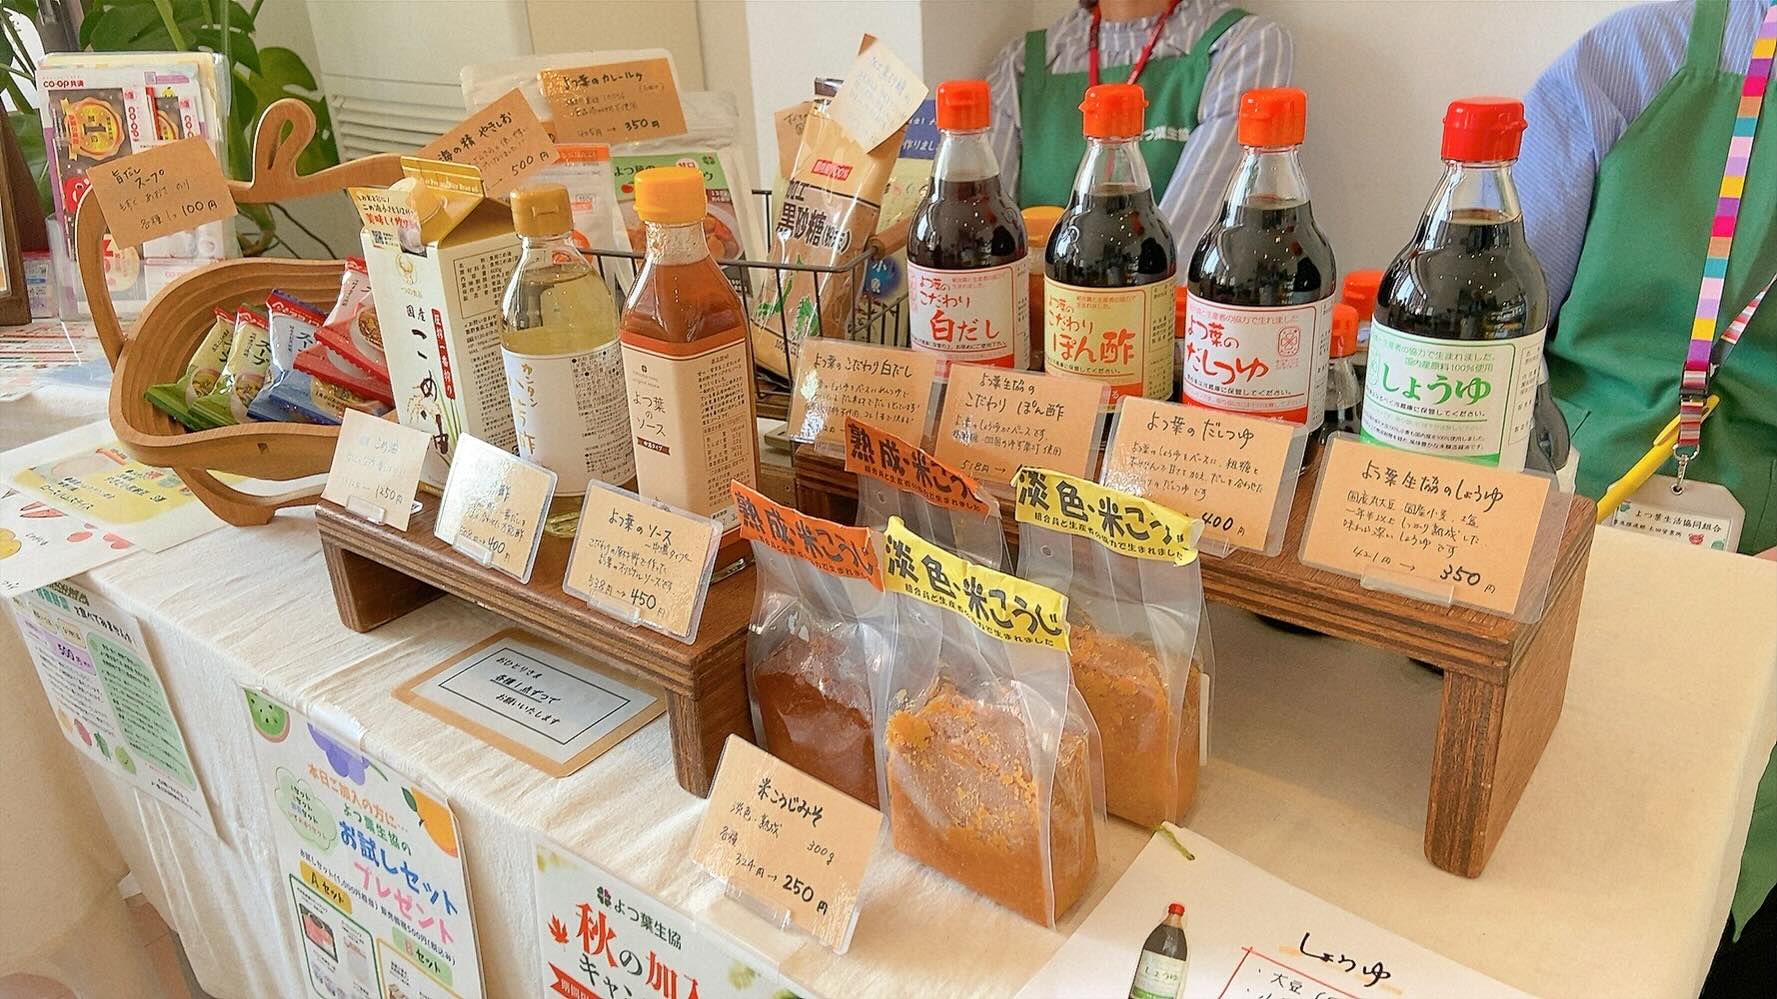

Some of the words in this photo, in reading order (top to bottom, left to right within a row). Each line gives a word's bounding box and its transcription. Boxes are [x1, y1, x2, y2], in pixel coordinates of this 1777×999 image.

[624, 117, 661, 131] 350円
[134, 169, 165, 190] スープ
[511, 151, 549, 176] 500円
[406, 304, 426, 322] 国産
[920, 290, 971, 308] こだわり
[930, 309, 1000, 342] 白だし
[1048, 310, 1094, 335] こだわり
[1187, 315, 1240, 350] よつ葉の
[1053, 328, 1137, 365] ぽん酢
[1186, 342, 1270, 385] だしつゆ
[1381, 362, 1492, 406] しょうゆ
[633, 391, 667, 414] よつ葉
[644, 410, 654, 420] の
[965, 391, 1008, 414] こだわり
[1017, 399, 1065, 422] ぽん酢
[636, 417, 667, 438] ソース
[1017, 465, 1186, 550] 淡色・米こ
[1201, 511, 1245, 537] 400円
[885, 534, 1063, 637] 淡色・米こうじ
[1439, 564, 1496, 595] 350円
[630, 587, 667, 619] 450円
[496, 657, 543, 679] おひとりさま
[495, 693, 560, 725] お願いいたします
[757, 776, 824, 828] 米こうじみそ
[343, 805, 412, 857] よつ葉生協の
[338, 819, 459, 916] お試しセット
[806, 839, 836, 867] 300g
[353, 860, 454, 945] プレゼント
[782, 874, 829, 916] 250円
[613, 898, 682, 951] よつ葉生協
[1299, 931, 1392, 989] しょうゆ
